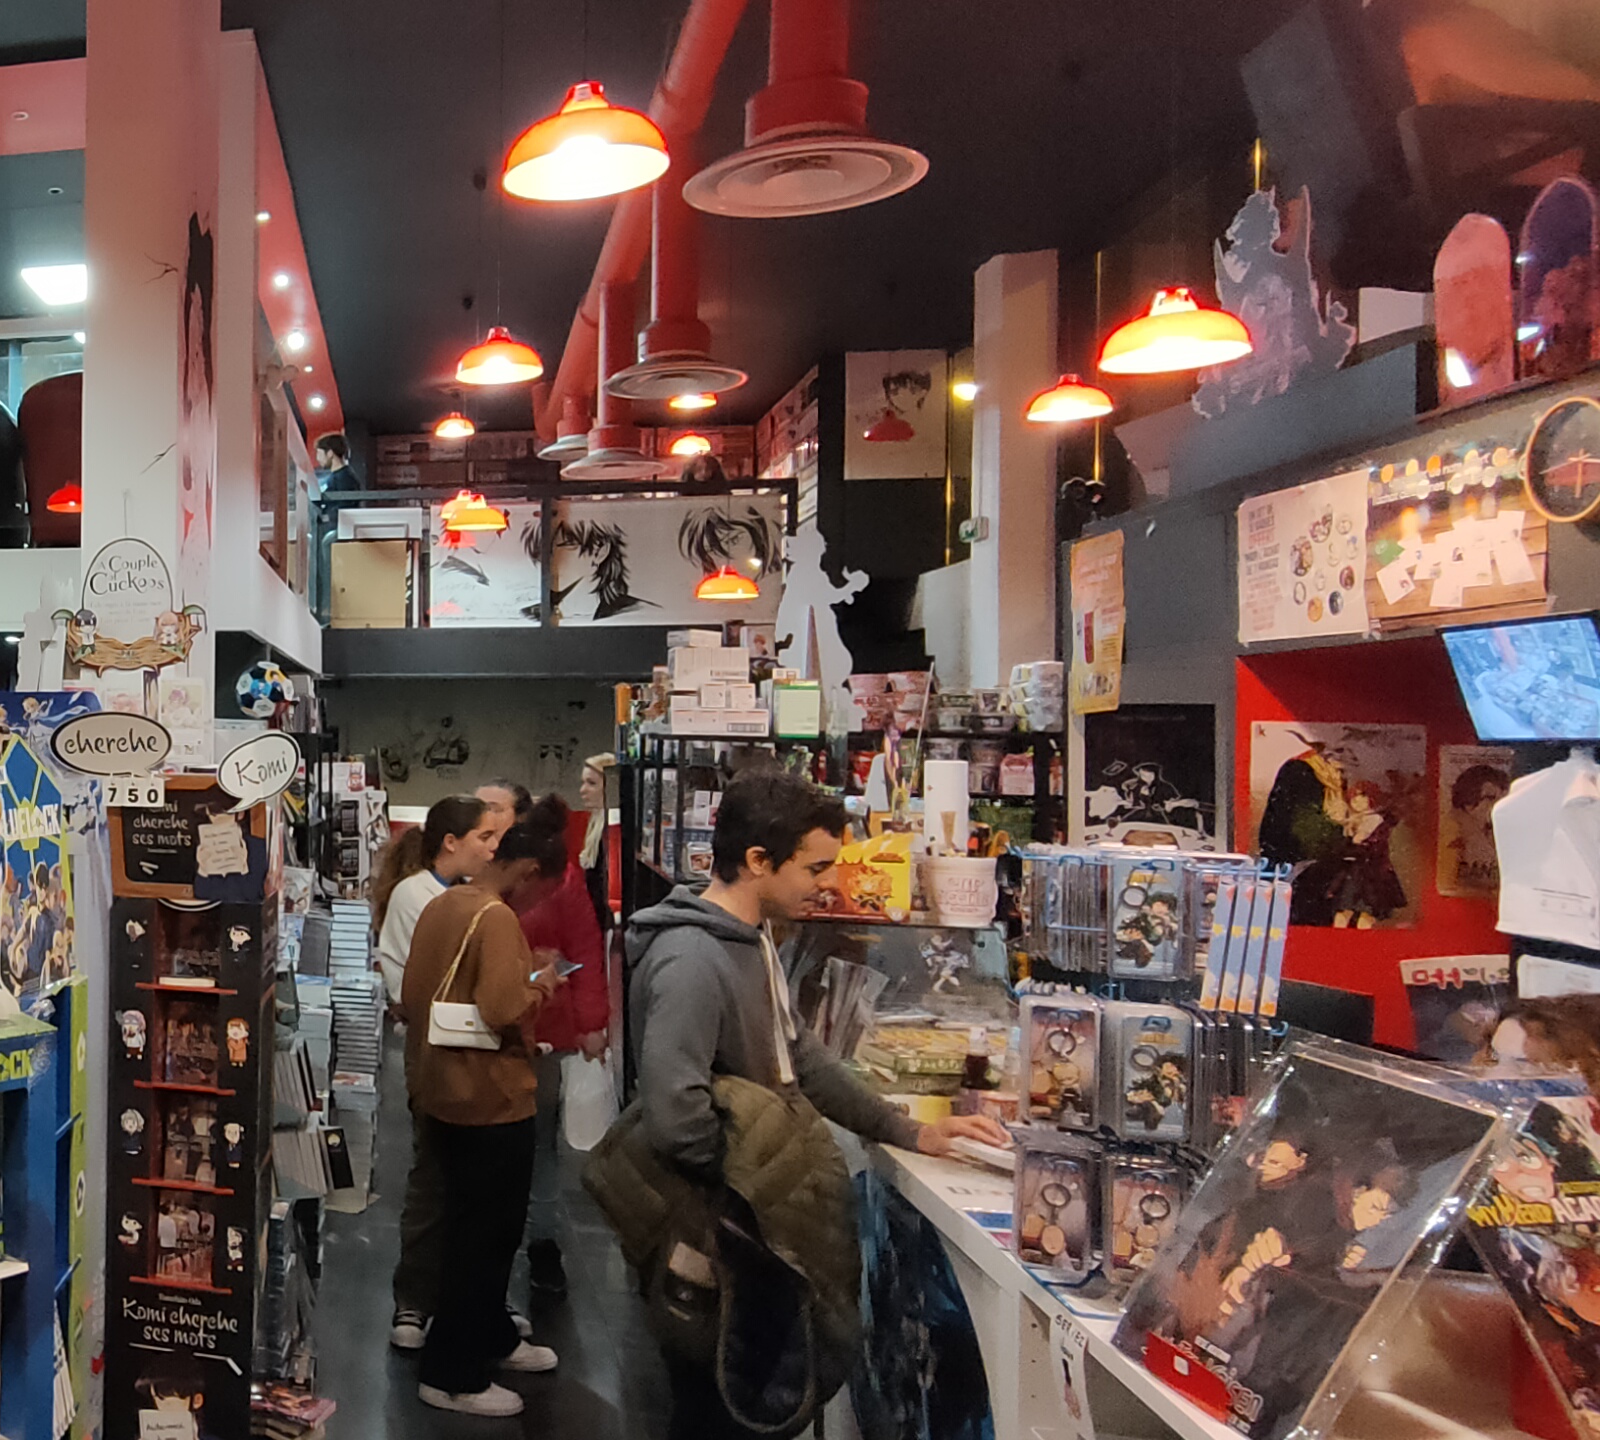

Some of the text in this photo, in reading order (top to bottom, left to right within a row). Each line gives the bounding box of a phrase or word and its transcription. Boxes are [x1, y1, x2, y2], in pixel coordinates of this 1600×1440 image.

[108, 554, 158, 574] Couple
[90, 571, 165, 595] Cuckoos
[64, 728, 160, 754] cherche
[234, 751, 288, 787] Komi
[133, 816, 190, 830] cherche
[132, 833, 192, 846] ses mots
[122, 1297, 238, 1333] Komi cherche
[143, 1324, 216, 1349] ses mots
